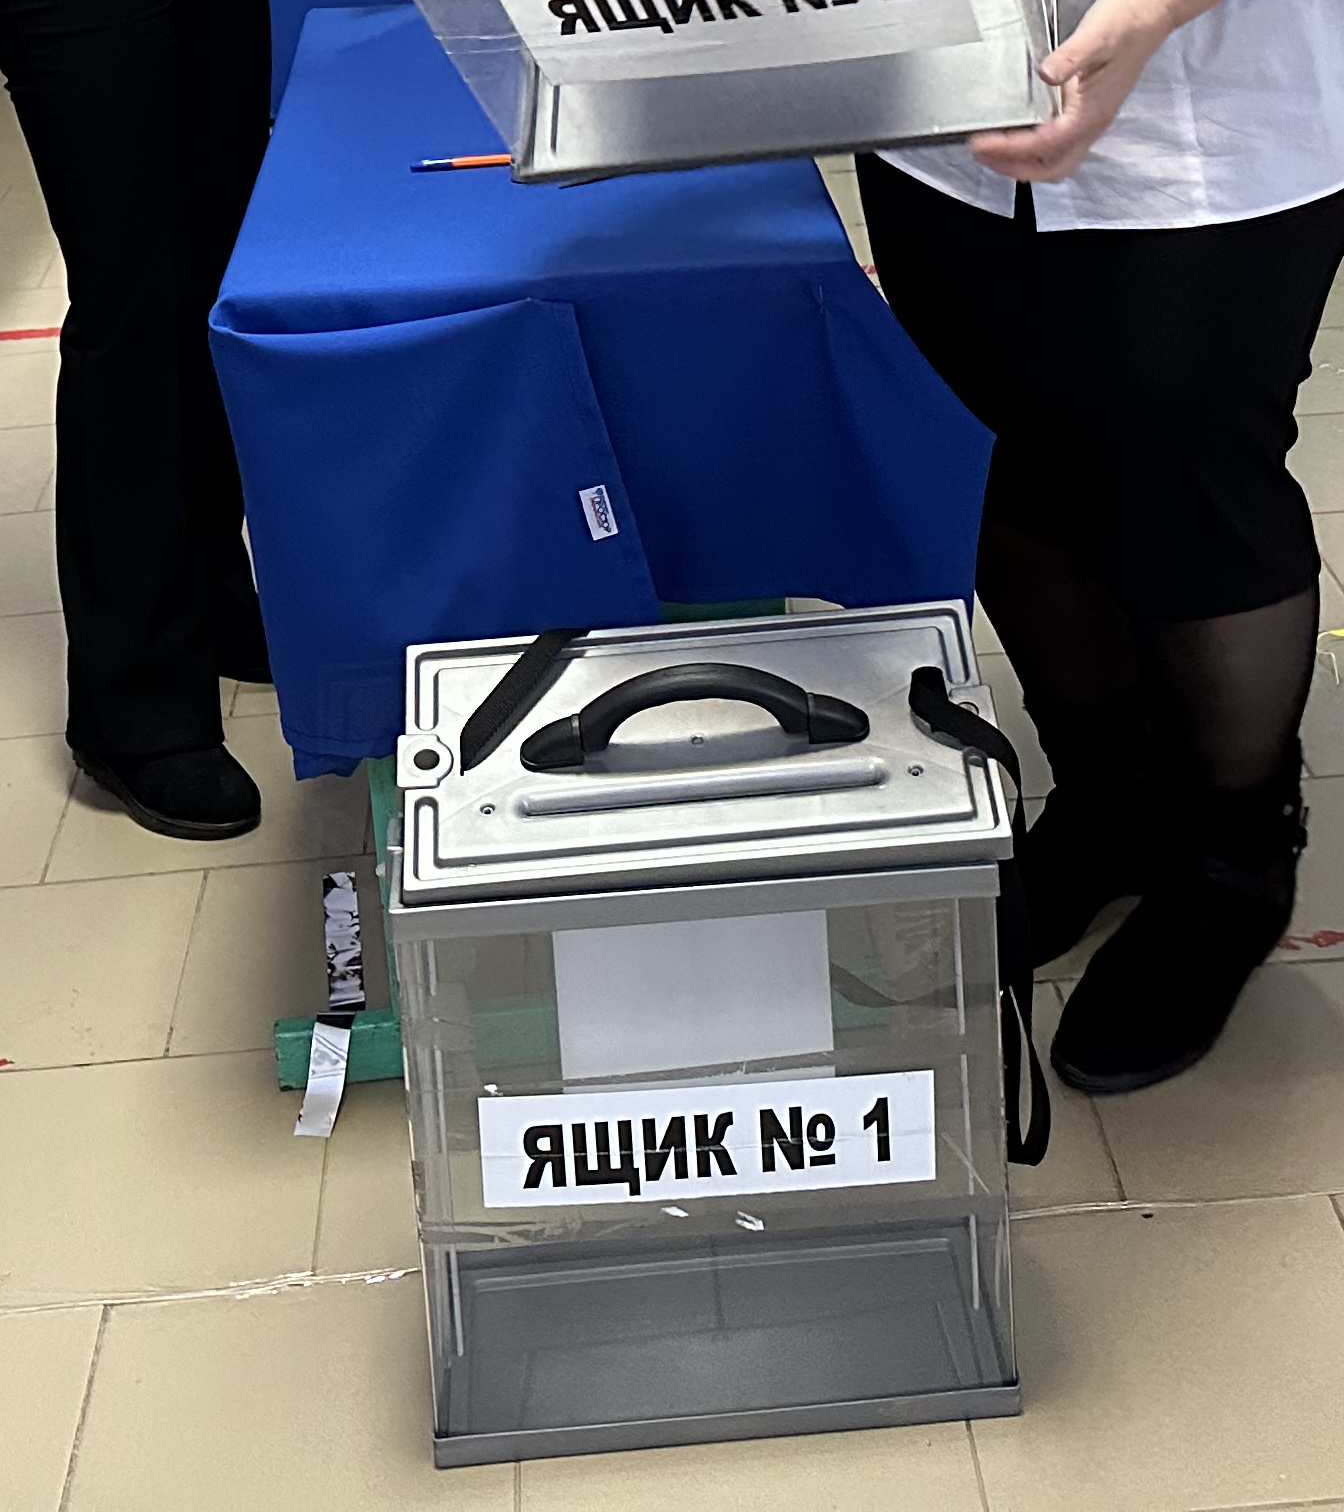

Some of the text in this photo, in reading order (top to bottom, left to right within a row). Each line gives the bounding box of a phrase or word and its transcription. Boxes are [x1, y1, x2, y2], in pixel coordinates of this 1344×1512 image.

[522, 1096, 892, 1197] ЯЩИК № 1
